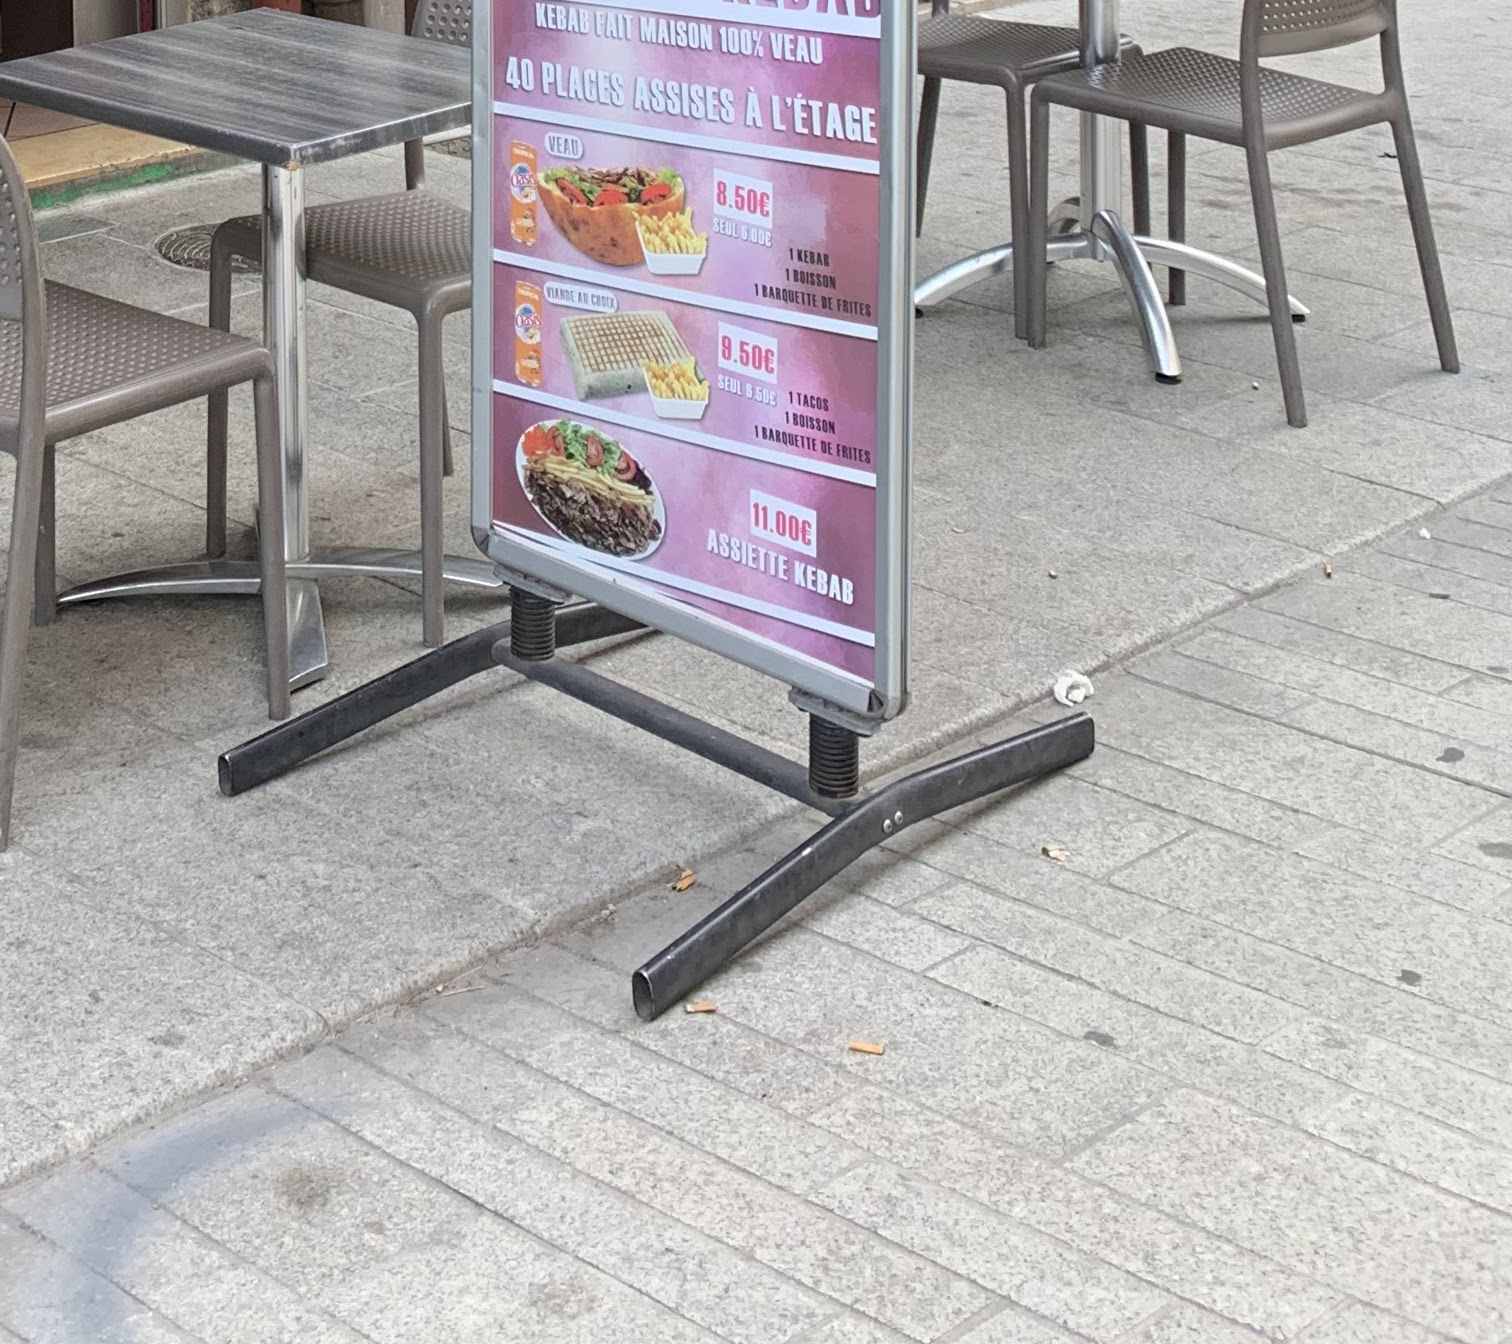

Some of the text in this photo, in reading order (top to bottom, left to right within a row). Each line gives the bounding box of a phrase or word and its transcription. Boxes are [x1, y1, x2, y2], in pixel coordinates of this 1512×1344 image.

[536, 3, 823, 65] KEBAB FAIT MAISON 100% VEAU
[506, 57, 878, 145] 40 PLACES ASSISES À L'ÉTAGE
[548, 135, 580, 157] VEAU
[716, 179, 771, 218] 8.50€
[713, 218, 773, 248] SEUL 6.00€
[789, 247, 830, 267] 1 KEBAB
[785, 268, 837, 290] 1 BOISSON
[545, 286, 616, 310] VIANDE AU CHOIX
[754, 283, 872, 318] 1 BARQUETTE DE FRITES
[721, 335, 775, 375] 9.50€
[718, 374, 743, 396] SEUL
[789, 391, 829, 412] 1 TACOS
[785, 411, 836, 435] 1 BOISSON
[754, 424, 871, 464] 1 BARQUETTE DE FRITES
[752, 501, 812, 547] 11.00€
[707, 527, 854, 605] ASSIETTE KEBAB
